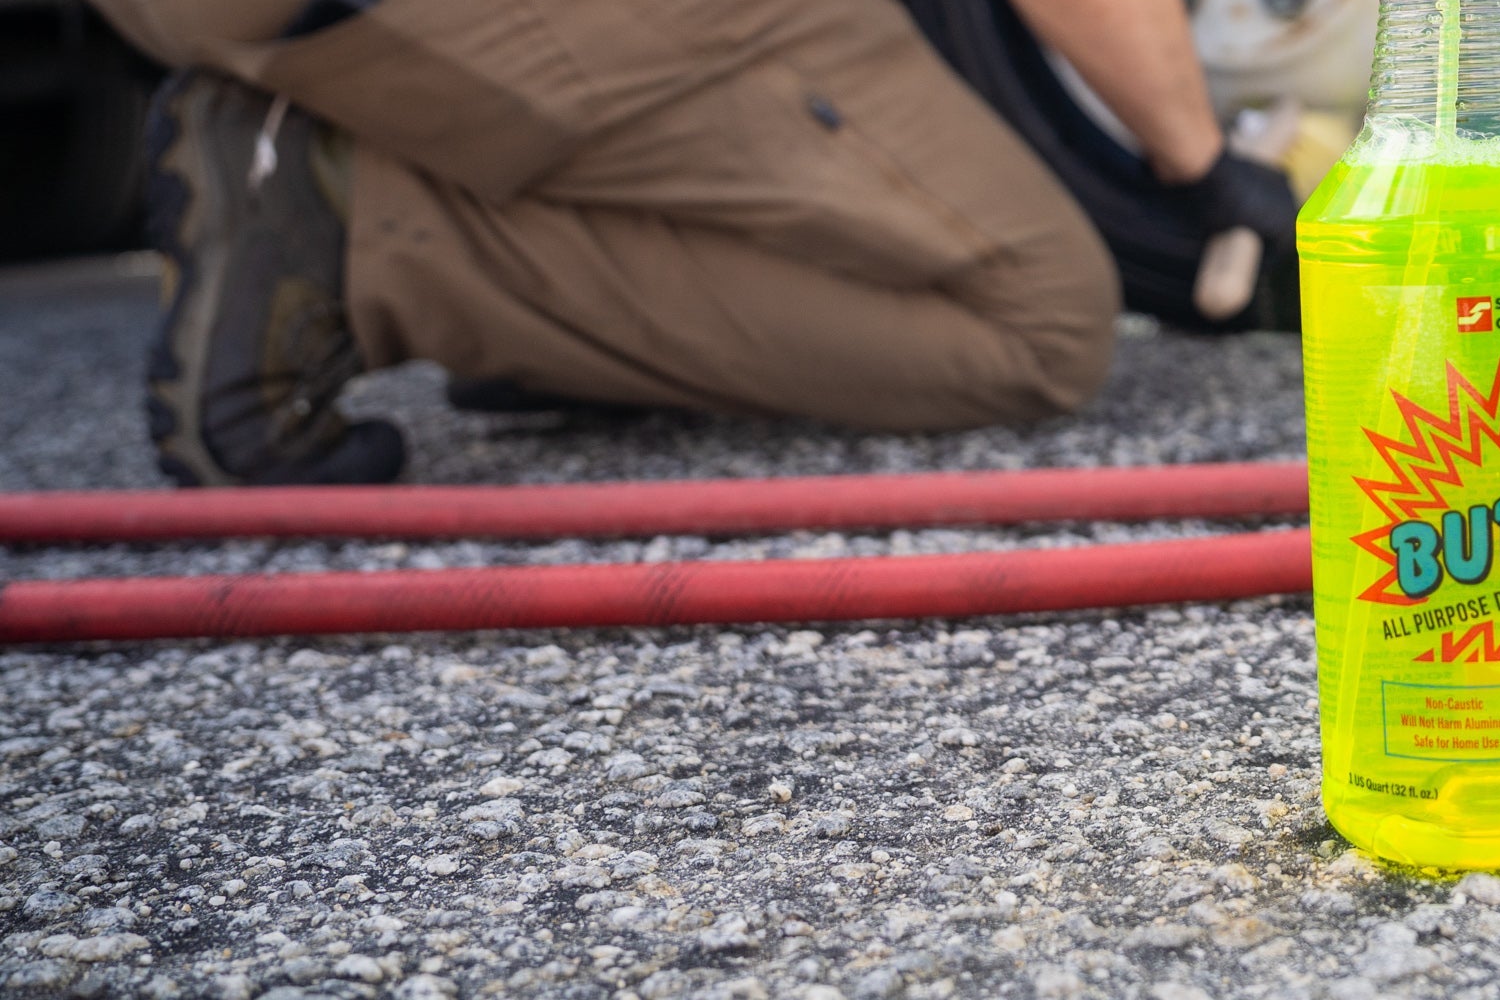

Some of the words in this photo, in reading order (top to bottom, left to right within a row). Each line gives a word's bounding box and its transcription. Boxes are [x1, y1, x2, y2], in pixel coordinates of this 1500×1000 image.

[1382, 616, 1411, 640] ALL
[1413, 596, 1491, 633] PURPOSE
[1425, 696, 1484, 710] Non-Caustic
[1401, 713, 1417, 727] Will
[1419, 715, 1435, 729] Not
[1437, 717, 1462, 729] Harm
[1414, 734, 1434, 748] Safe
[1436, 736, 1449, 748] for
[1452, 737, 1479, 749] Home
[1482, 736, 1500, 748] Use
[1349, 772, 1353, 784] 1
[1354, 773, 1365, 788] US
[1366, 778, 1389, 794] Quart
[1391, 783, 1407, 797] (32
[1409, 785, 1418, 798] fl.
[1420, 788, 1438, 800] oz.)
